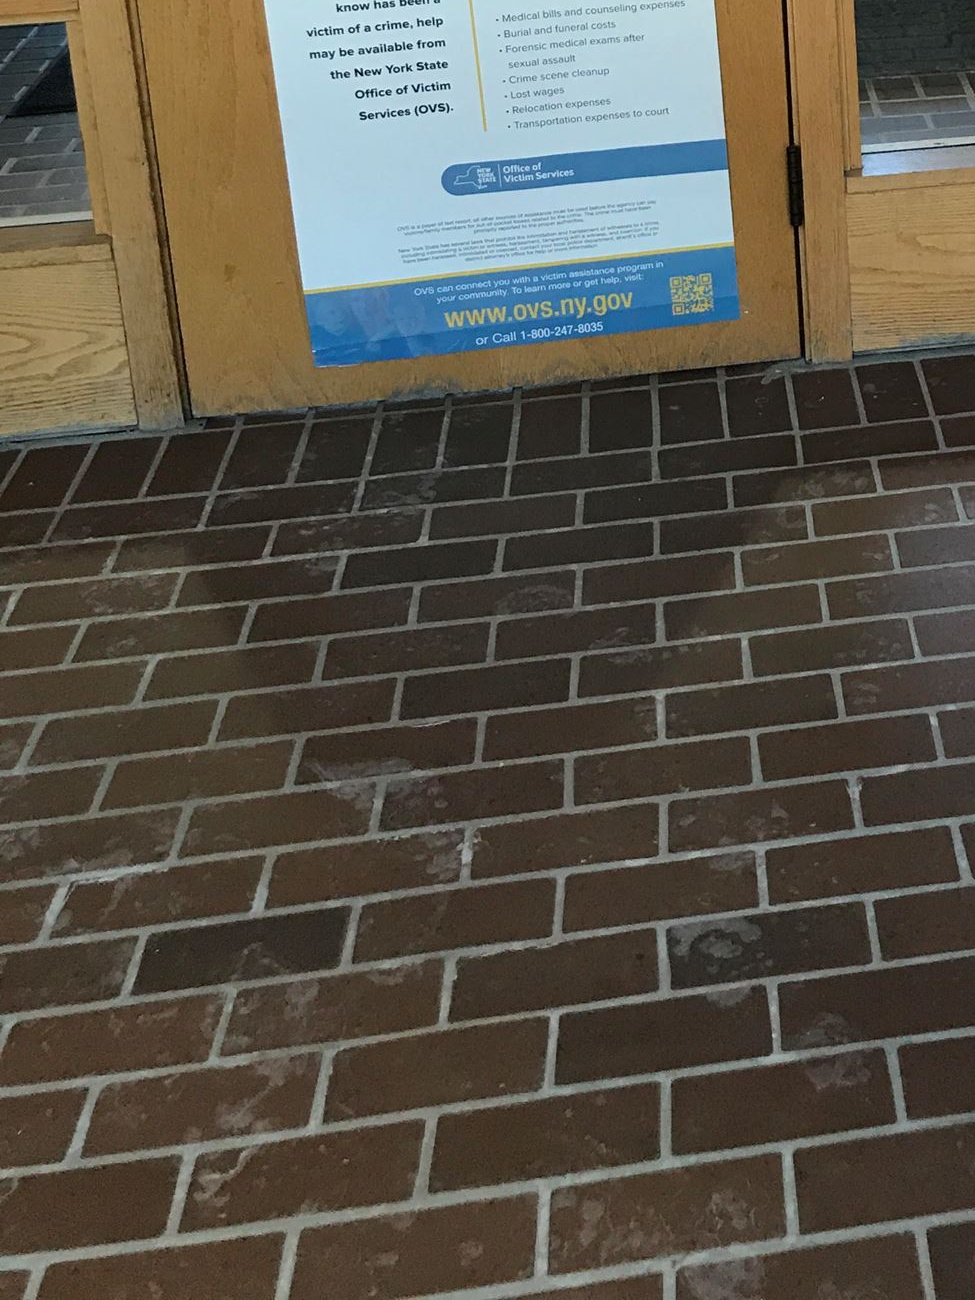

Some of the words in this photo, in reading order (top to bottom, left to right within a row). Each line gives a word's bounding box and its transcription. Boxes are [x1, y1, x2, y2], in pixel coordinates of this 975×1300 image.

[336, 3, 370, 12] know
[374, 0, 395, 10] has
[502, 12, 539, 23] Medical
[543, 9, 561, 19] bills
[564, 8, 582, 16] and
[585, 3, 637, 15] counseling
[640, 0, 685, 11] expenses
[306, 26, 344, 37] victim
[348, 24, 361, 34] of
[364, 25, 371, 33] a
[375, 21, 413, 32] crime,
[417, 17, 443, 28] help
[504, 28, 531, 39] Burial
[534, 26, 552, 35] and
[555, 22, 588, 33] funeral
[591, 21, 616, 30] costs
[309, 50, 335, 61] may
[339, 48, 354, 57] be
[358, 42, 413, 55] available
[417, 39, 446, 49] from
[506, 43, 547, 53] Forensic
[550, 38, 587, 49] medical
[590, 36, 620, 46] exams
[623, 33, 645, 42] after
[330, 70, 350, 79] the
[354, 68, 383, 78] New
[386, 64, 412, 74] York
[416, 60, 448, 71] State
[508, 58, 539, 69] sexual
[542, 54, 575, 64] assault
[509, 74, 537, 84] Crime
[540, 71, 569, 81] scene
[572, 67, 610, 78] cleanup
[355, 87, 392, 99] Office
[396, 85, 408, 95] of
[411, 81, 451, 93] Victim
[511, 90, 530, 99] Lost
[533, 87, 564, 97] wages
[359, 107, 410, 120] Services
[415, 102, 454, 116] (OVS).
[512, 102, 562, 114] Relocation
[565, 97, 611, 109] expenses
[514, 115, 582, 130] Transportation
[585, 111, 630, 124] expenses
[633, 109, 642, 118] to
[645, 107, 669, 117] court
[503, 165, 530, 174] Office
[533, 162, 541, 171] of
[503, 174, 533, 182] Victim
[536, 169, 574, 180] Services
[444, 291, 633, 328] www.ovs.ny.gov
[475, 336, 489, 346] or
[492, 331, 516, 344] Call
[520, 322, 603, 341] 1-800-247-8035
